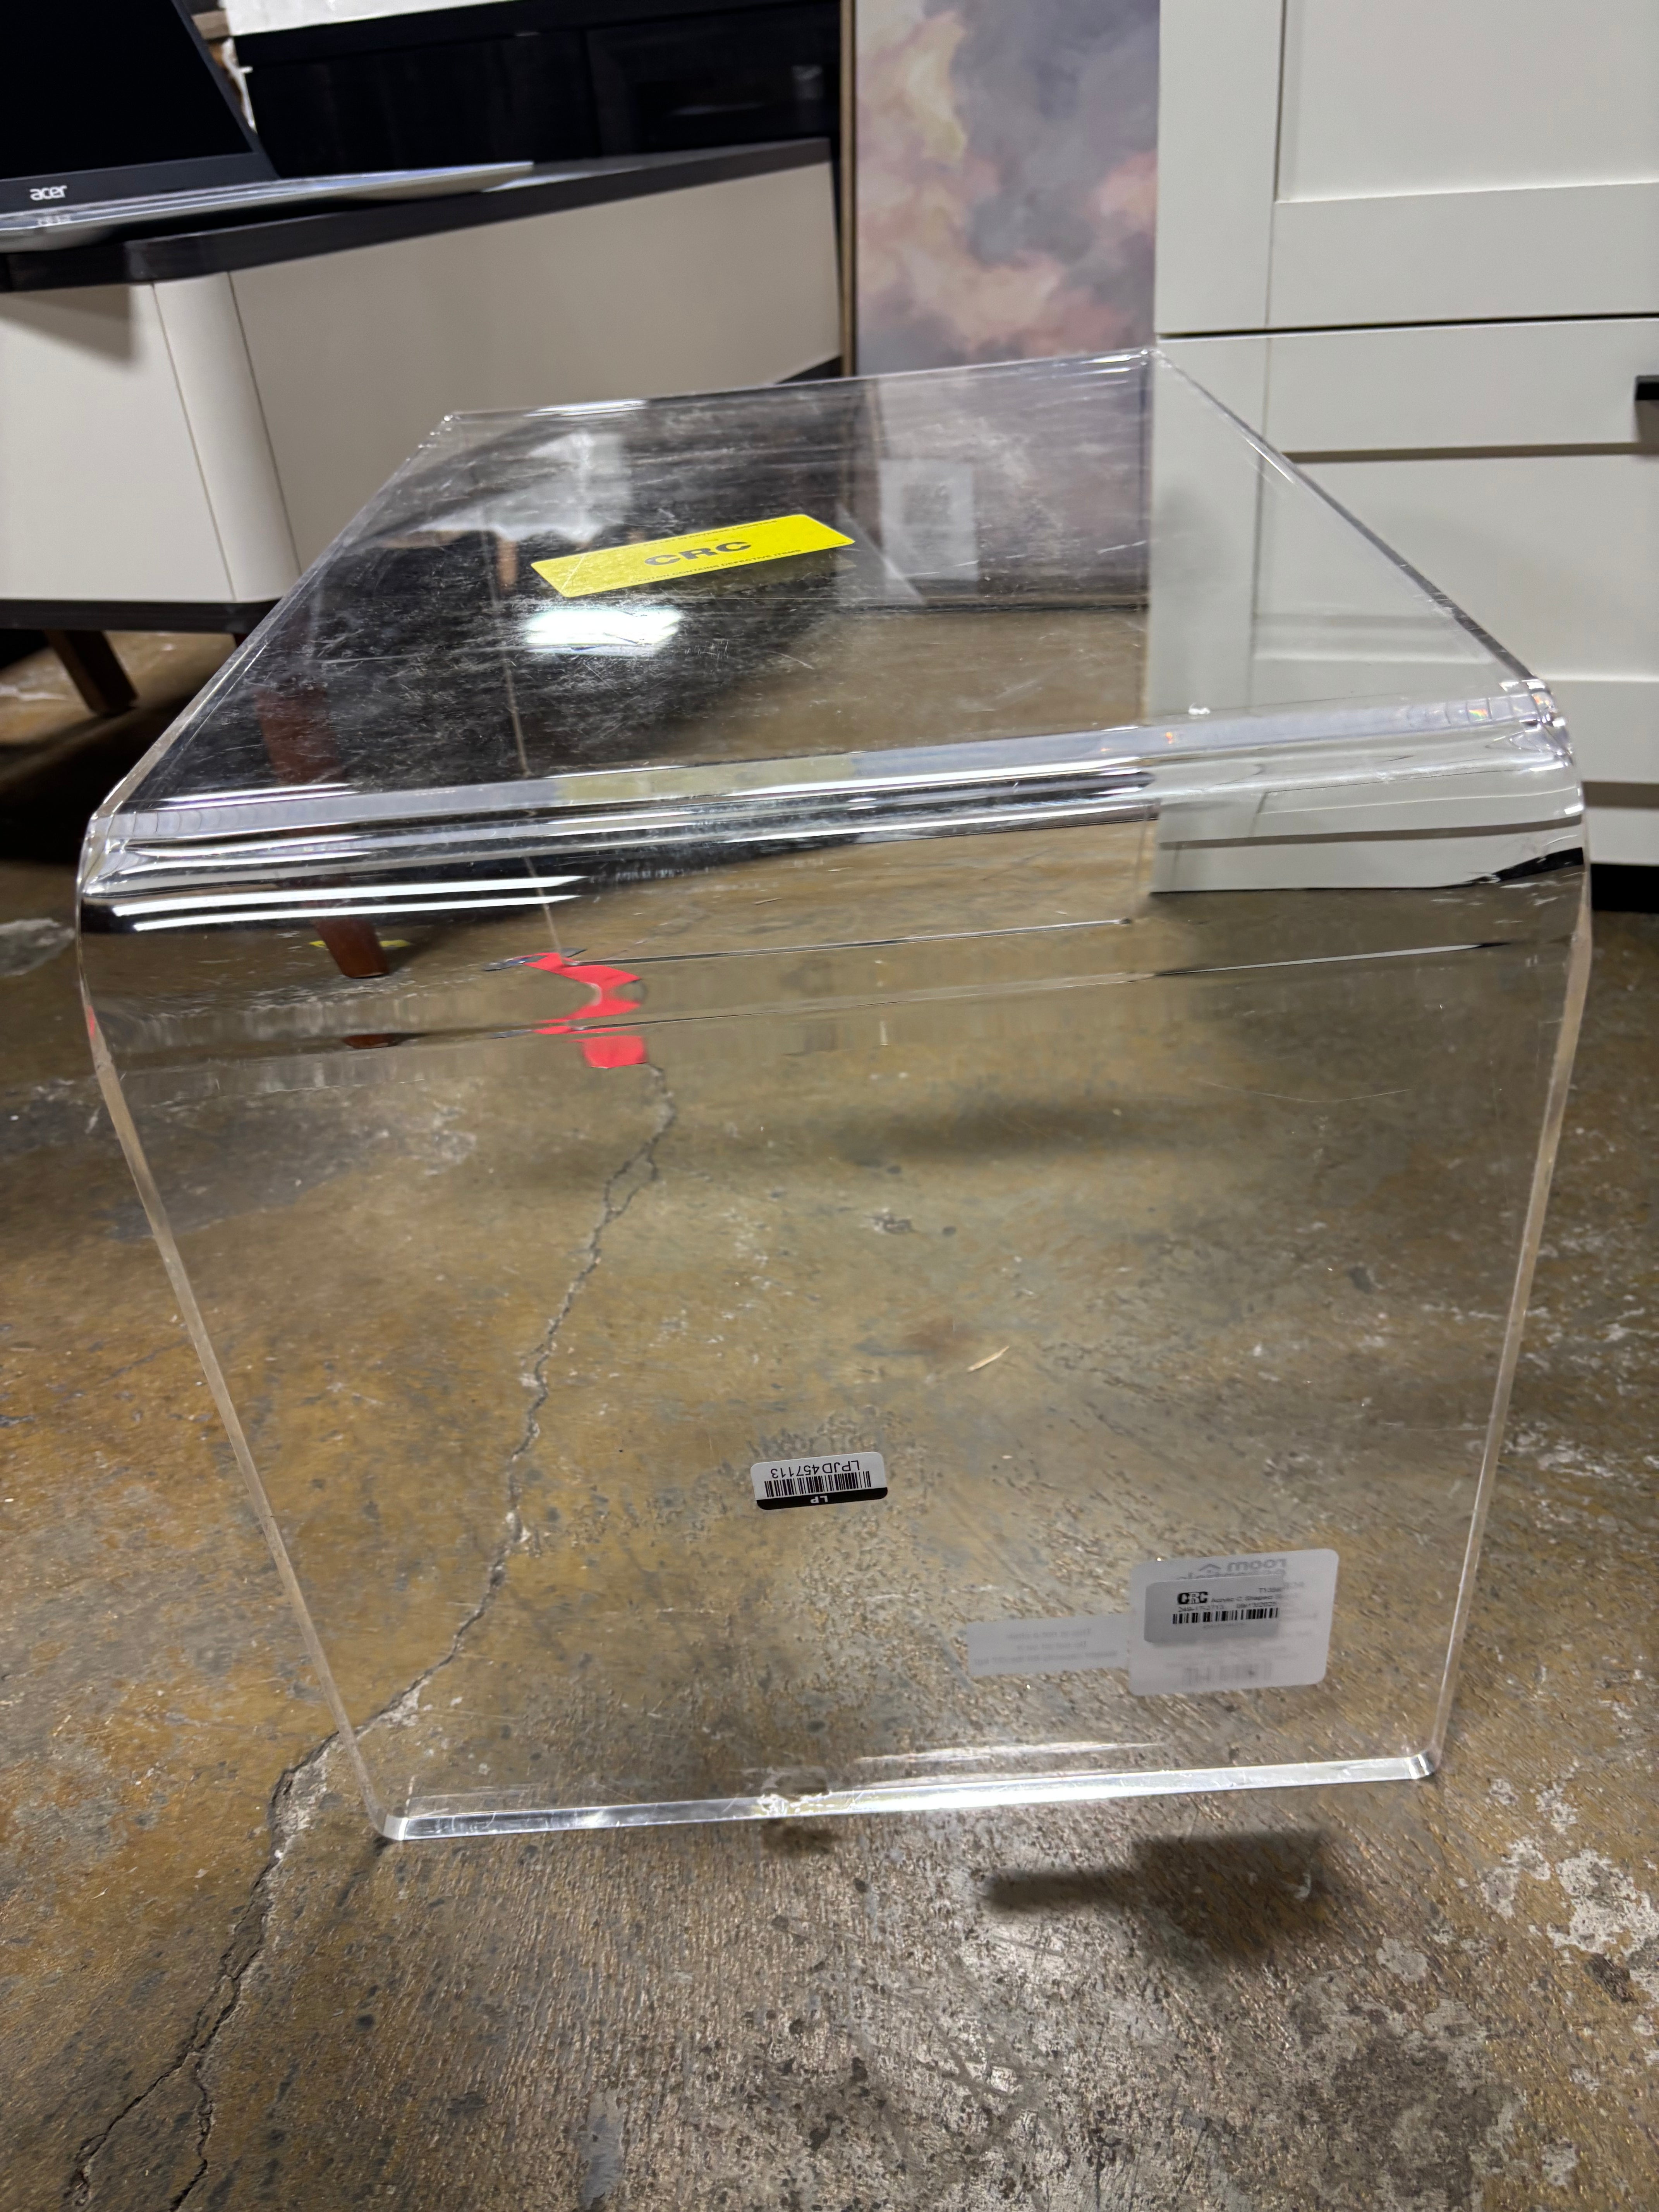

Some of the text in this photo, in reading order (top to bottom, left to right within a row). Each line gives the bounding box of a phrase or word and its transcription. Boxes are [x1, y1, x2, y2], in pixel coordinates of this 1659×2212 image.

[29, 185, 67, 201] acer
[644, 541, 752, 566] CRC
[770, 1460, 860, 1479] LPJD457113
[810, 1495, 828, 1503] LP
[1177, 1591, 1208, 1605] CRC
